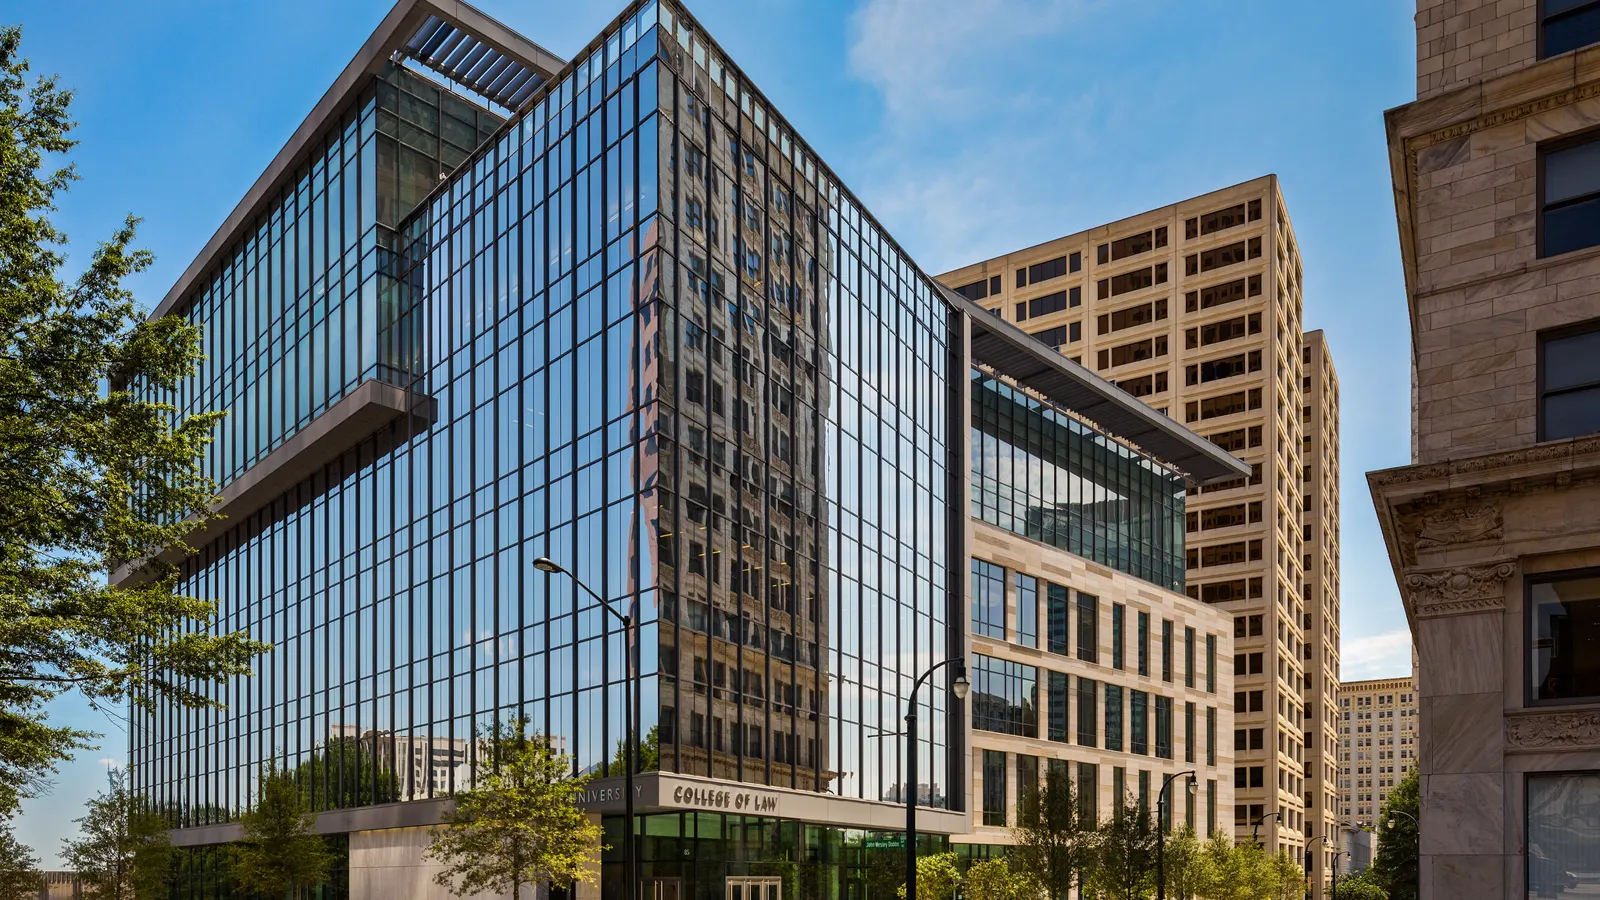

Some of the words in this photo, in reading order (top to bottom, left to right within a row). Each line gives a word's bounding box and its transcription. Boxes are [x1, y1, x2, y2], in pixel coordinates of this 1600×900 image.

[570, 785, 643, 804] NIVERSIY
[674, 786, 730, 808] COLLEGE
[735, 793, 749, 810] OF
[755, 795, 777, 812] LAW
